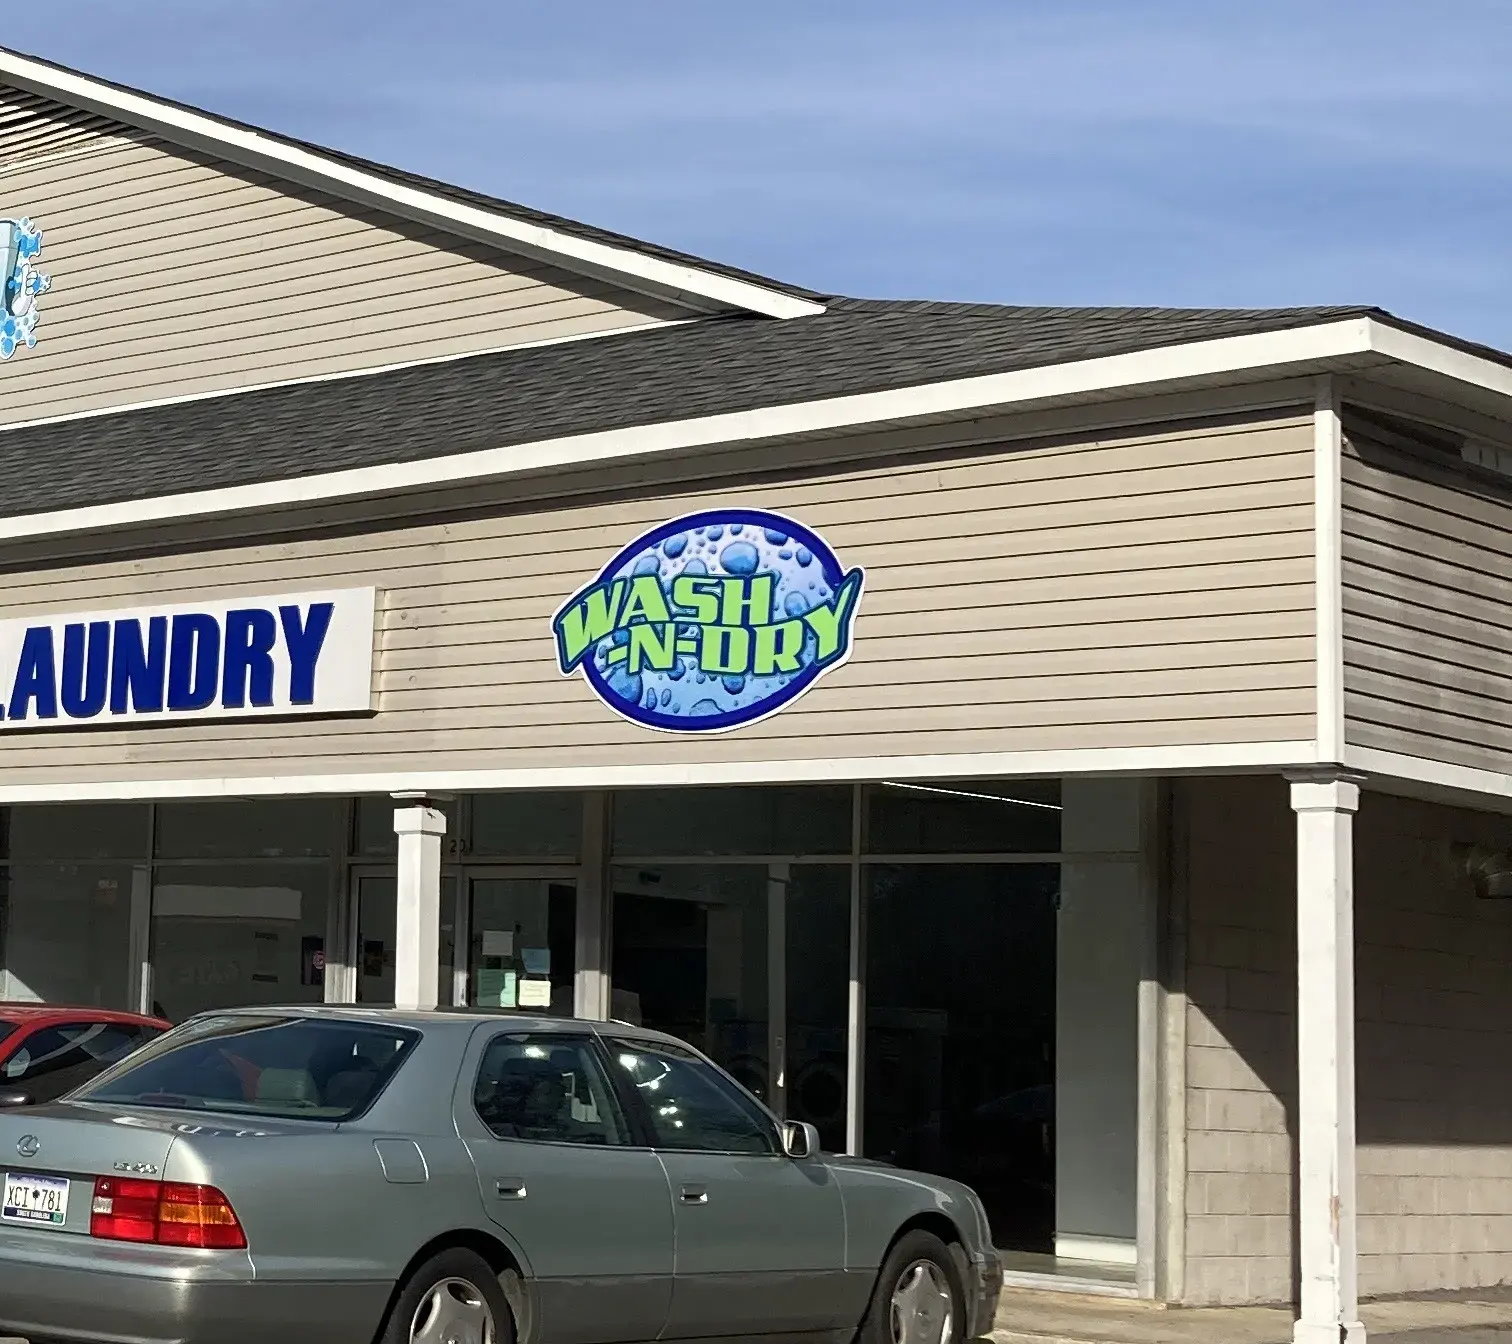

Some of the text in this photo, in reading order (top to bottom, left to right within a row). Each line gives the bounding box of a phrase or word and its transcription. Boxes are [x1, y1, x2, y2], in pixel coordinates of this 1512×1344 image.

[557, 574, 774, 665] WASH
[7, 1185, 62, 1212] XCI 781
